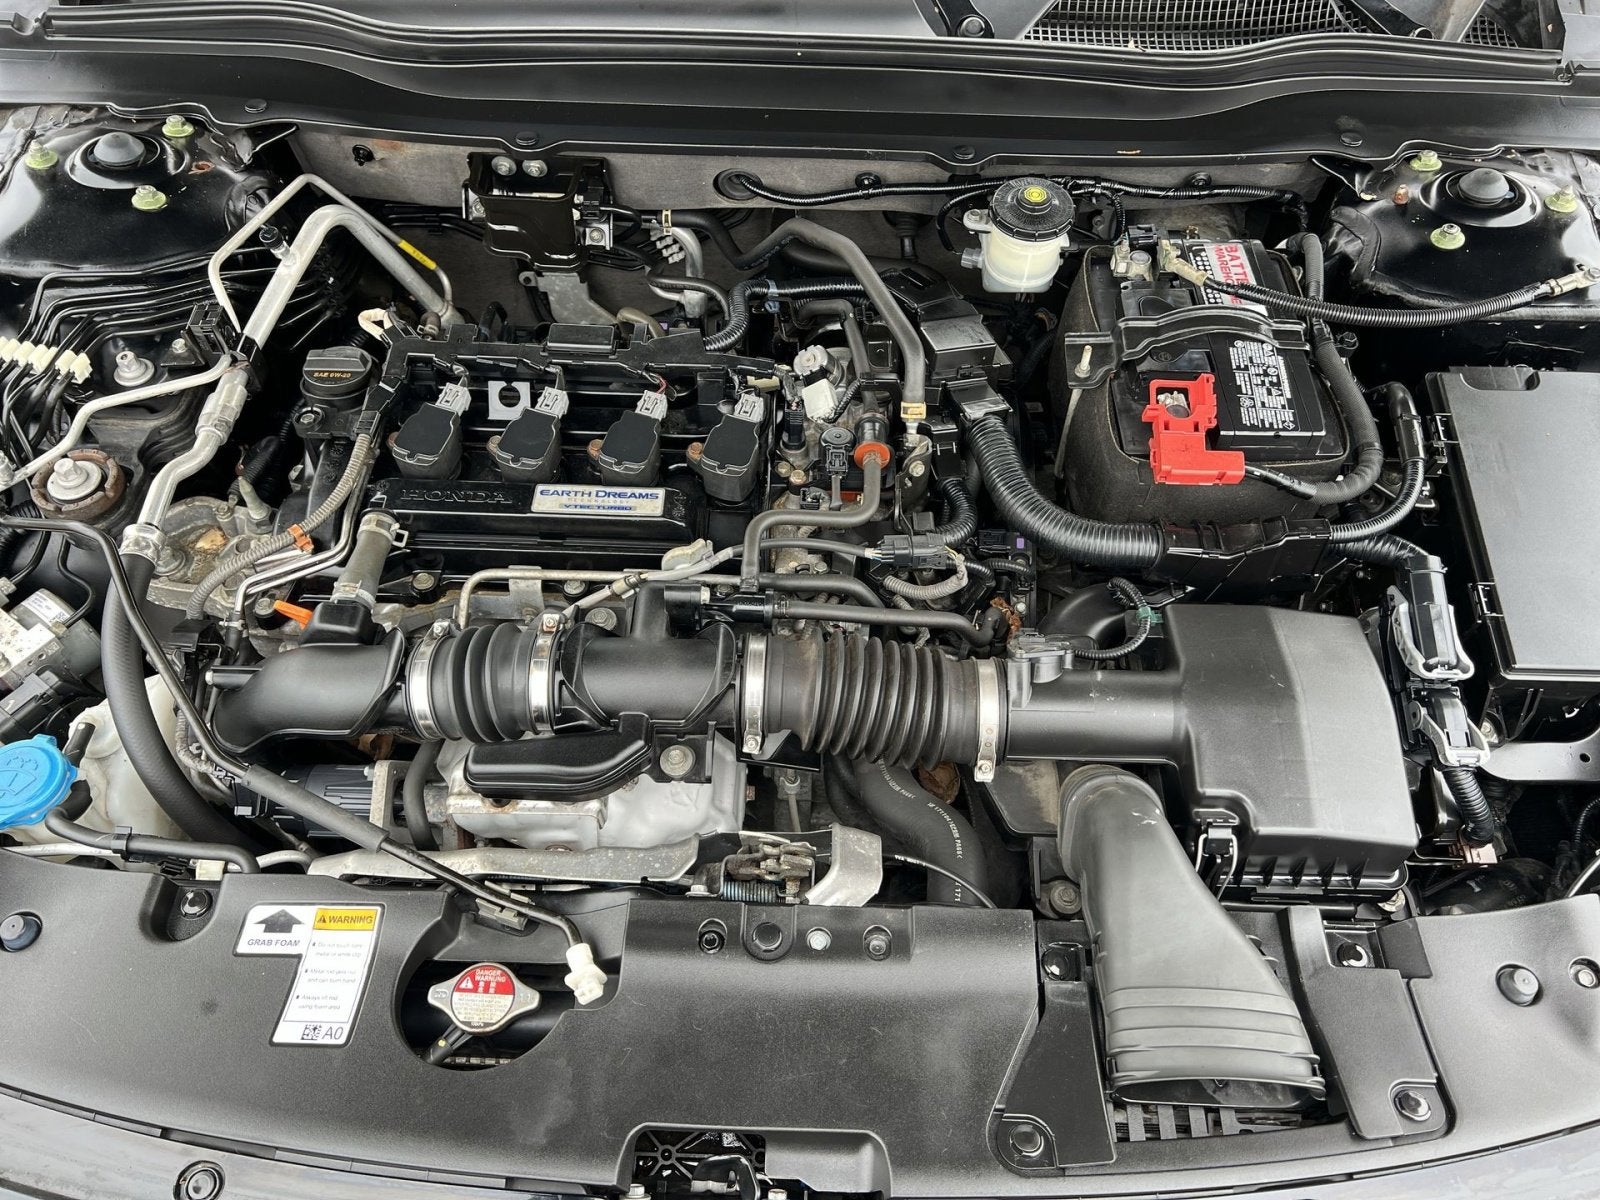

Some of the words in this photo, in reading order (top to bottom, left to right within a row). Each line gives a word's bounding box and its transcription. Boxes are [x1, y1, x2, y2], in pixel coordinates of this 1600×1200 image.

[1224, 244, 1249, 286] BATTE
[1214, 244, 1242, 305] WAREHOE
[400, 489, 513, 504] HONDA
[539, 489, 592, 498] EARTH
[595, 489, 660, 500] DREAMS
[328, 915, 374, 924] WARNING
[247, 938, 273, 946] GRAB
[475, 969, 502, 977] DANGER
[321, 1025, 345, 1040] A0
